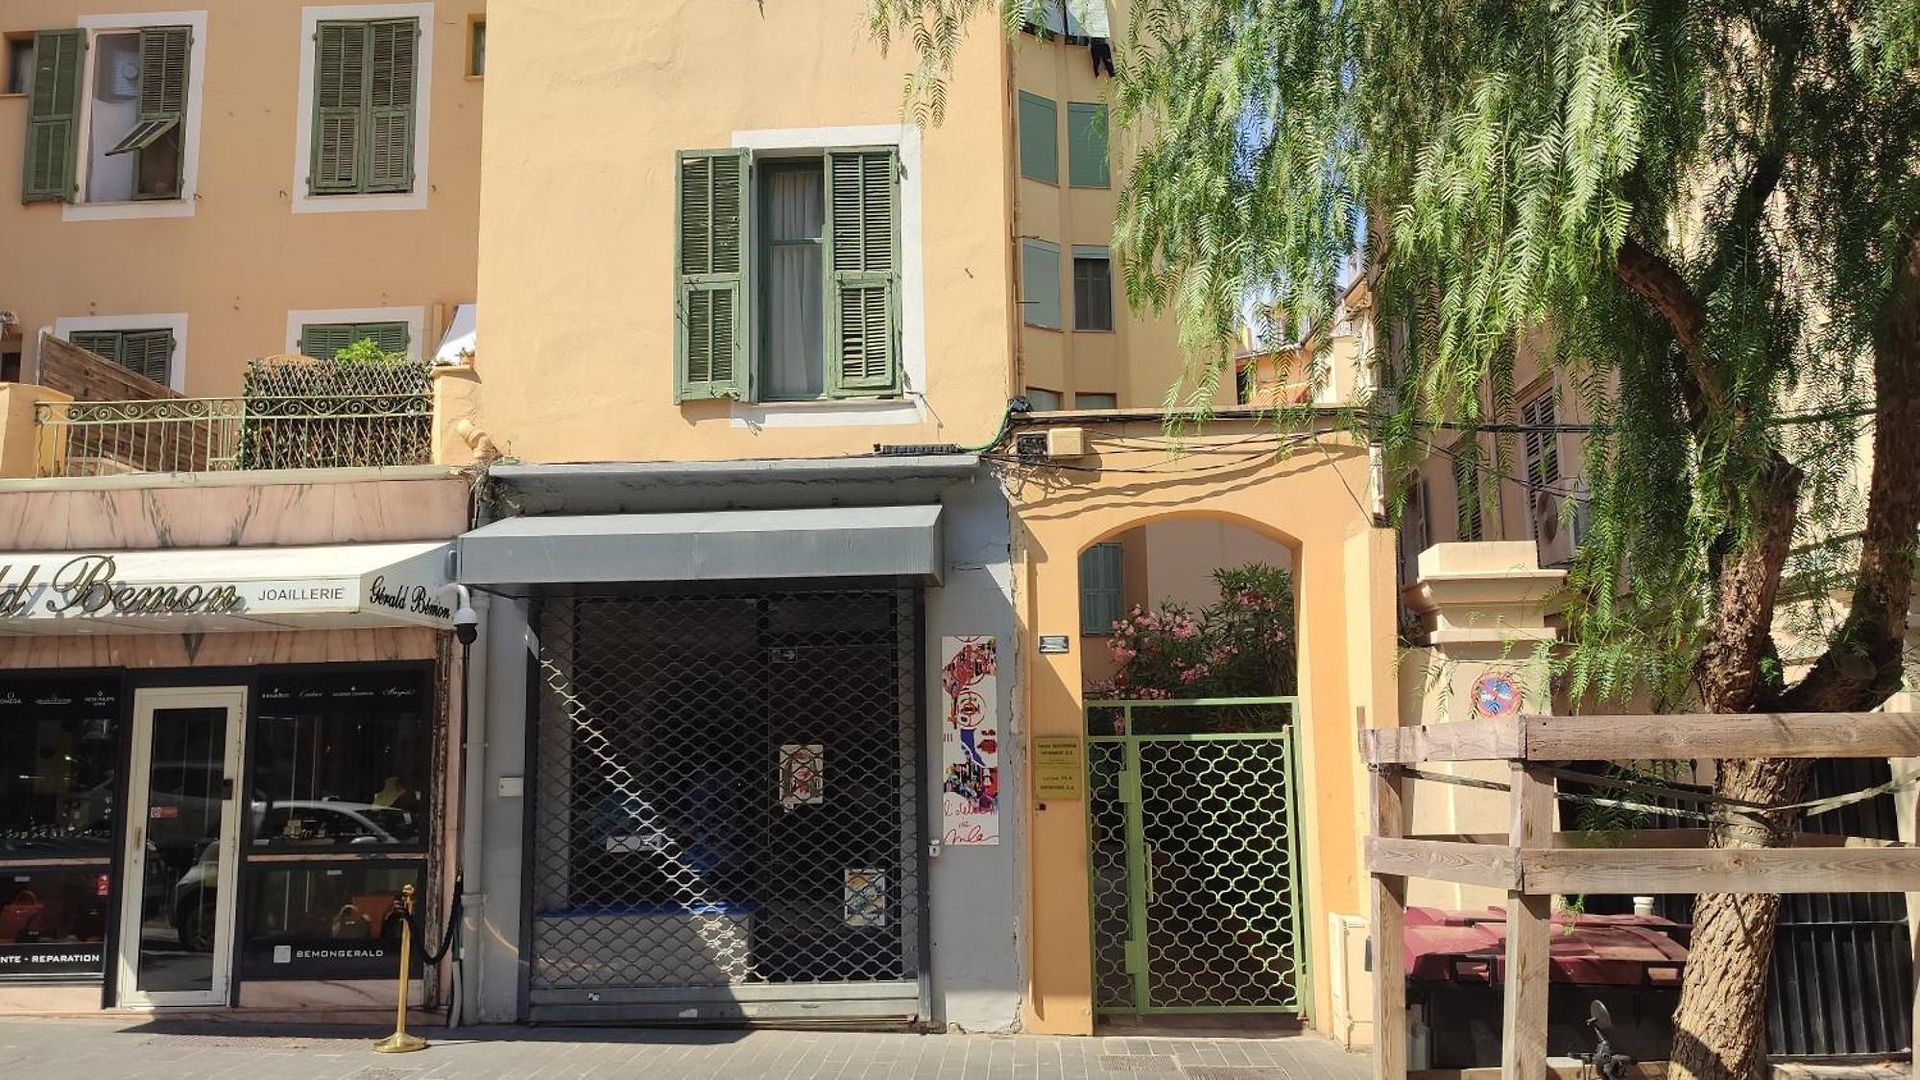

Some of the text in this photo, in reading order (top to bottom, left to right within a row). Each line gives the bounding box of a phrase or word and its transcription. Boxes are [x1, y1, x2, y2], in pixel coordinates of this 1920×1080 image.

[45, 554, 241, 613] Bemon
[258, 587, 344, 601] JOAILLERIE
[0, 955, 21, 963] NTE
[31, 953, 100, 963] REPARATION
[296, 949, 384, 959] BEMONGERALD
